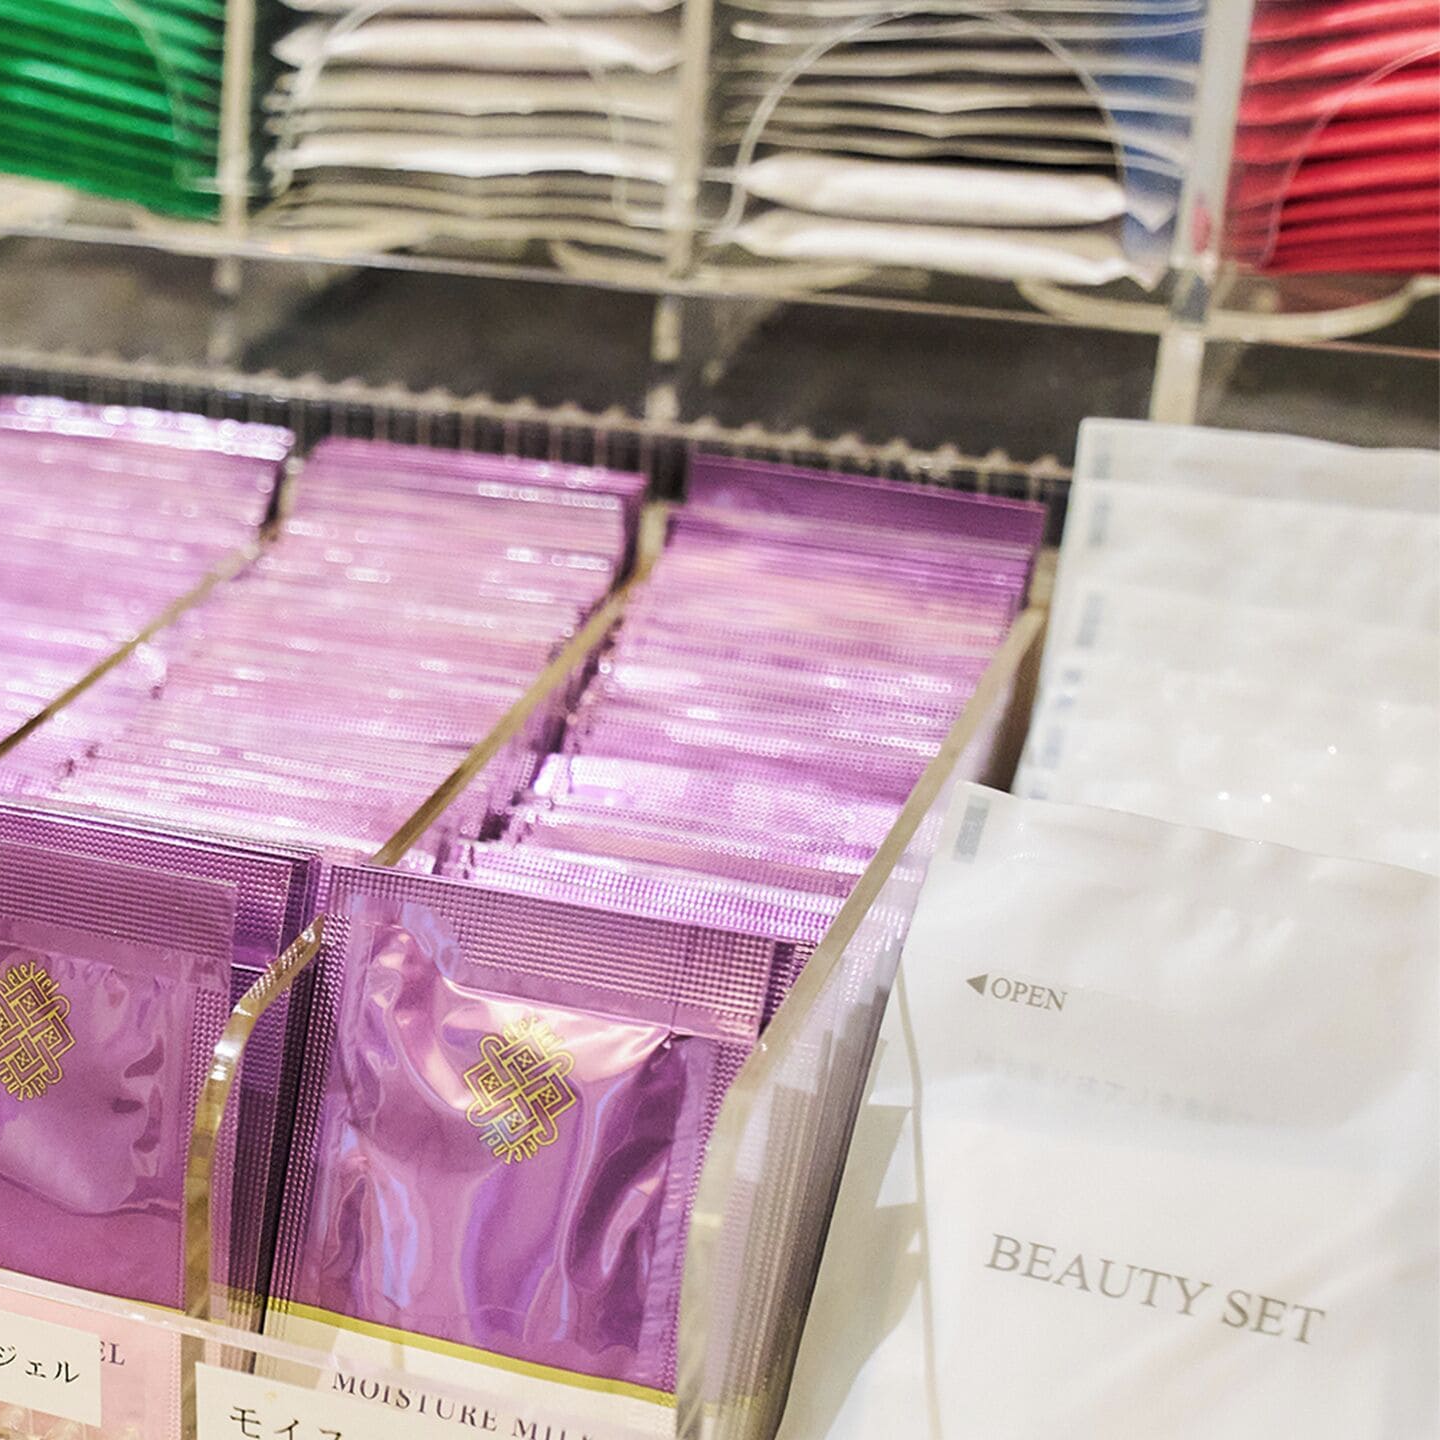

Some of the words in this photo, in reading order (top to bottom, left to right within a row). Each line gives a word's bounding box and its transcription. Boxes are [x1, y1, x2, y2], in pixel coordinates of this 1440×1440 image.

[991, 977, 1068, 1011] OPEN
[984, 1233, 1213, 1316] BEAUTY
[1221, 1288, 1326, 1345] SET
[330, 1372, 498, 1432] MOISTURE
[511, 1418, 593, 1440] MIL
